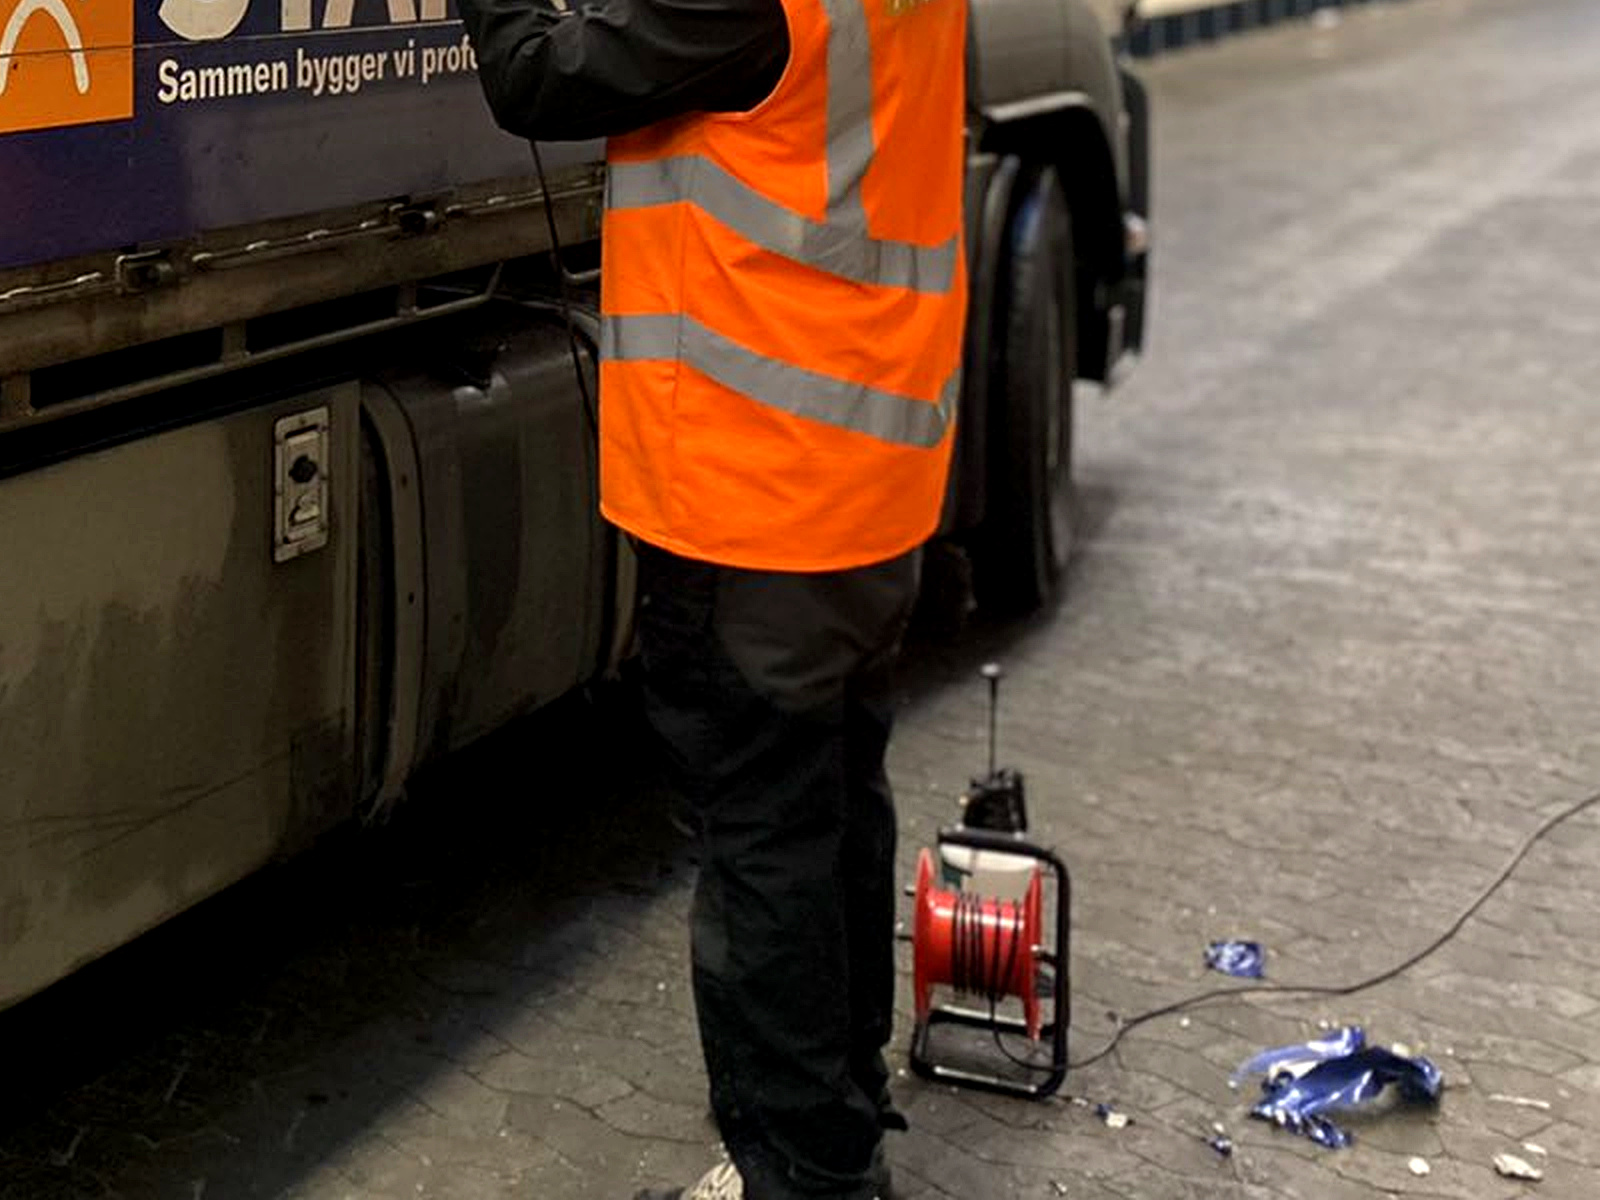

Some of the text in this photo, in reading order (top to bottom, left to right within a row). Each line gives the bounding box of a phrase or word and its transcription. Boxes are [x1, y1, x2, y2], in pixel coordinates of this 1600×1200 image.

[157, 58, 288, 103] Sammen
[296, 47, 387, 97] bygger
[393, 38, 415, 78] vi
